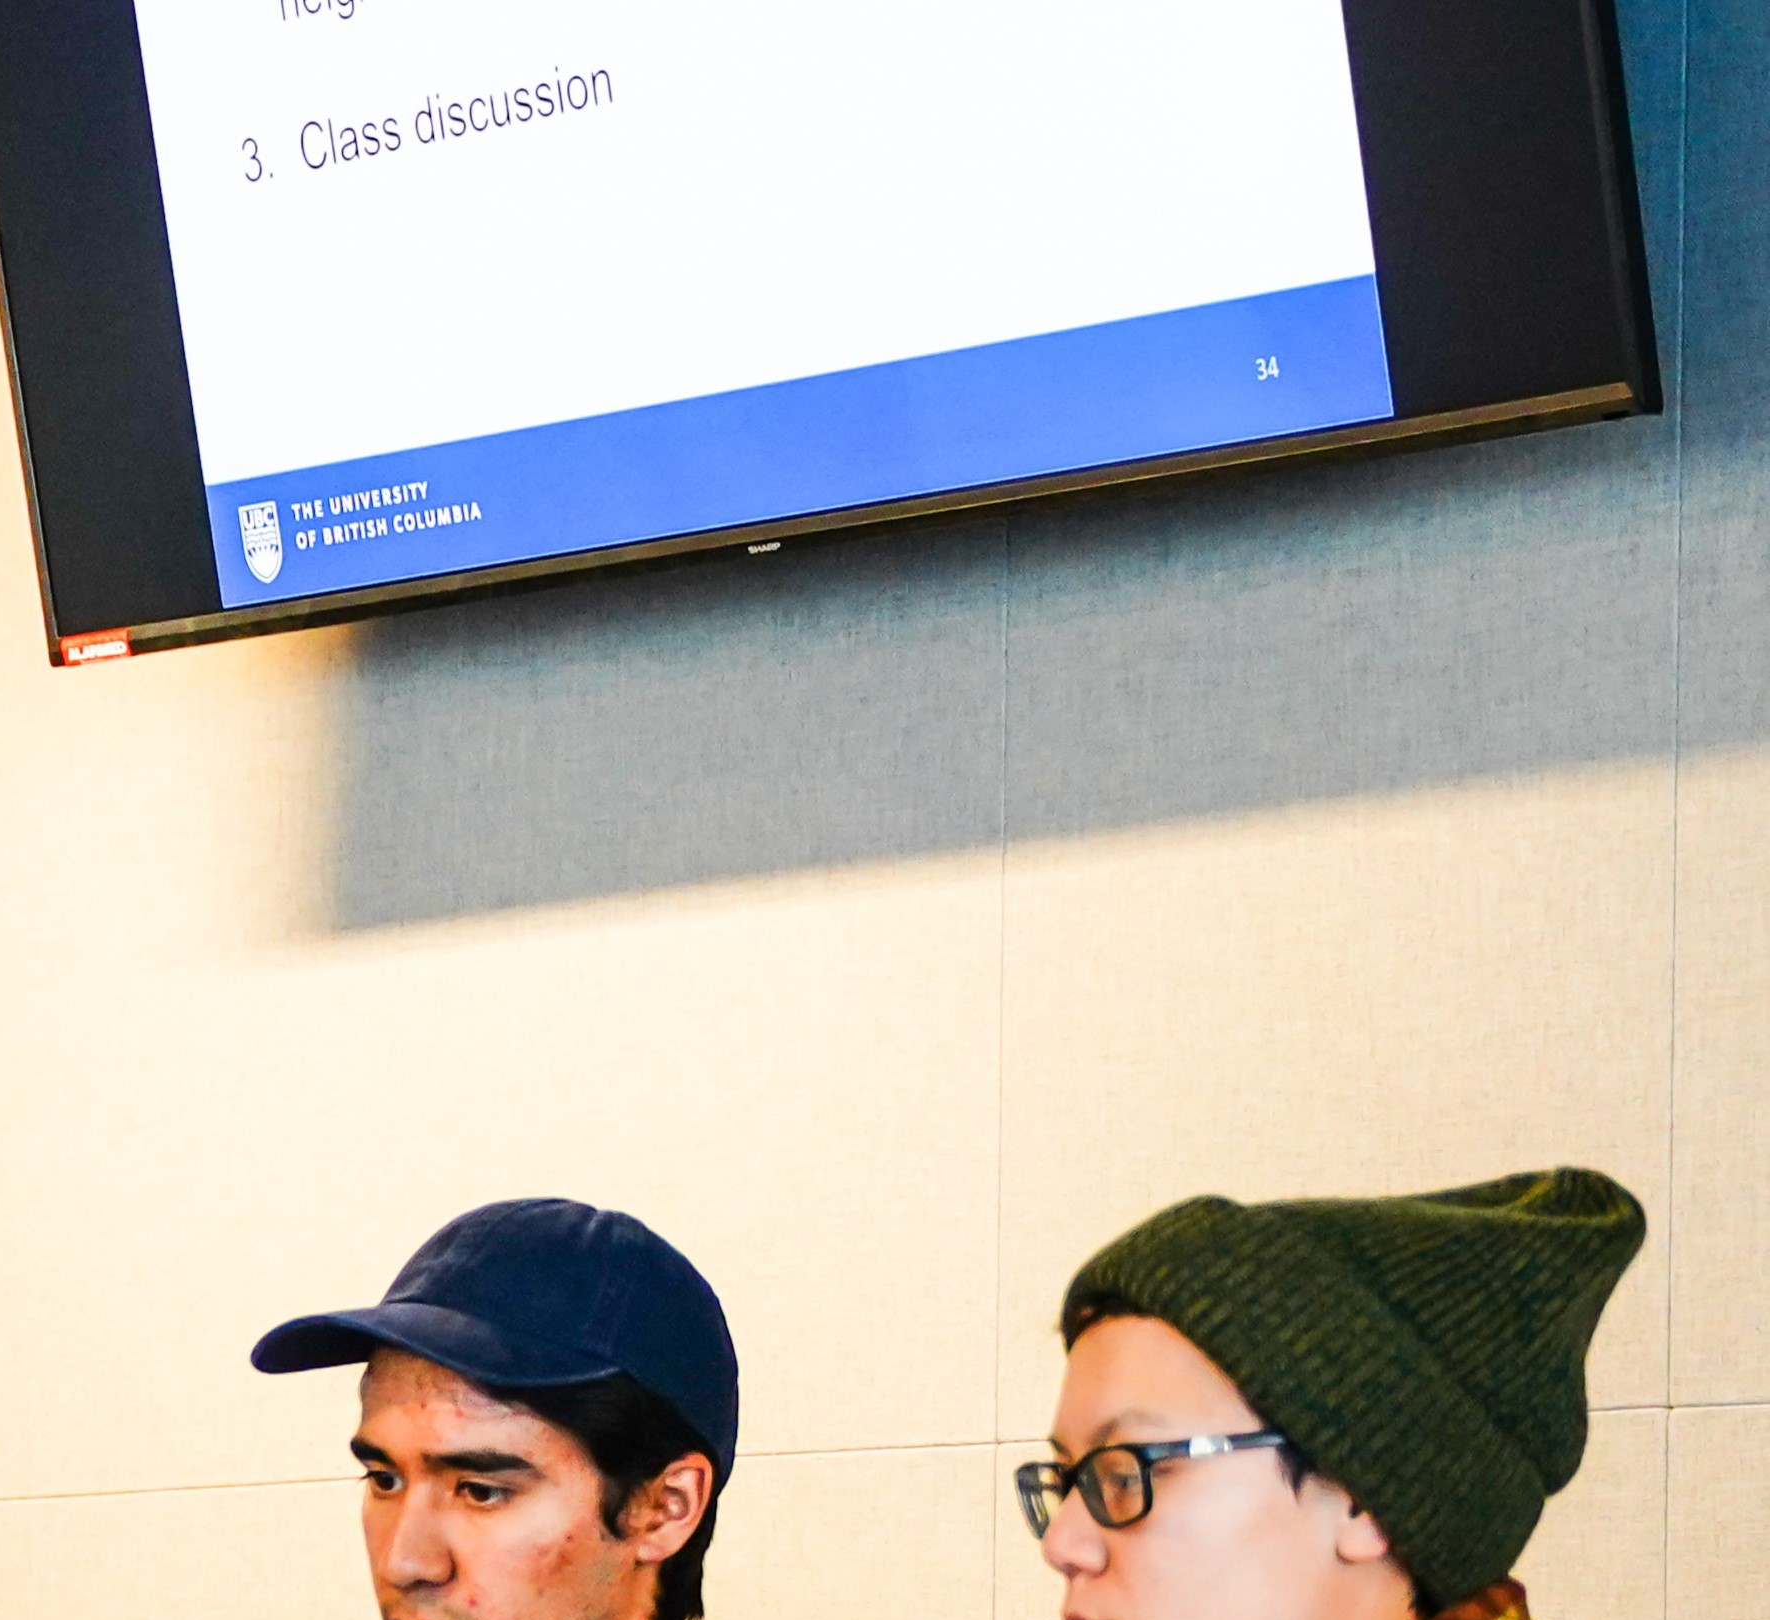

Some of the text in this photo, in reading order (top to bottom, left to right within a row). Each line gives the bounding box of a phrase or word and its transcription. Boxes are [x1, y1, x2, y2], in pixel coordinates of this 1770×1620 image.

[241, 65, 613, 182] 3. Class discussion
[1255, 355, 1280, 381] 34
[241, 506, 275, 530] UBC
[291, 481, 429, 522] THE UNIVERSITY
[295, 501, 482, 551] OF BRITISH COLUMBIA
[747, 541, 782, 555] SHARP
